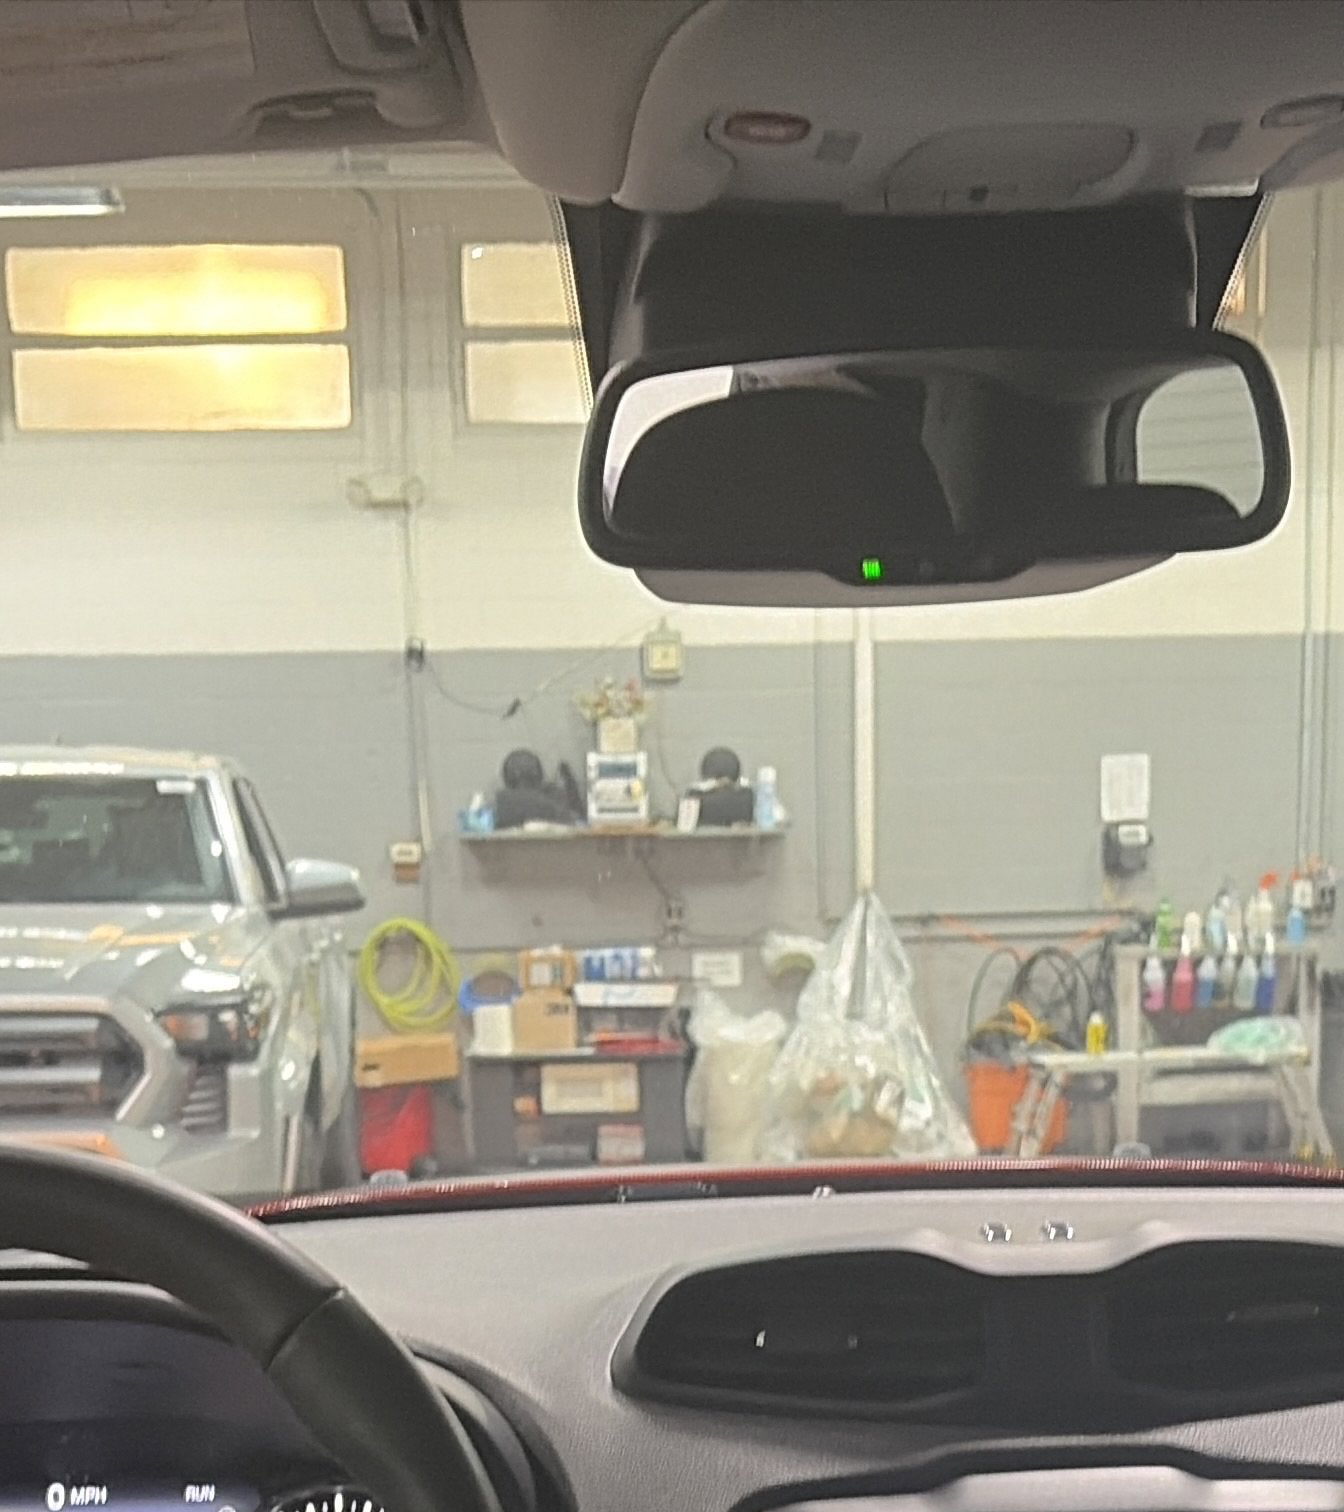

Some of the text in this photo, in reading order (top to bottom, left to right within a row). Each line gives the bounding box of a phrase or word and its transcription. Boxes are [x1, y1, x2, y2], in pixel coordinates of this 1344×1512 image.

[46, 1482, 107, 1511] 0 MPH
[185, 1484, 215, 1502] RUN
